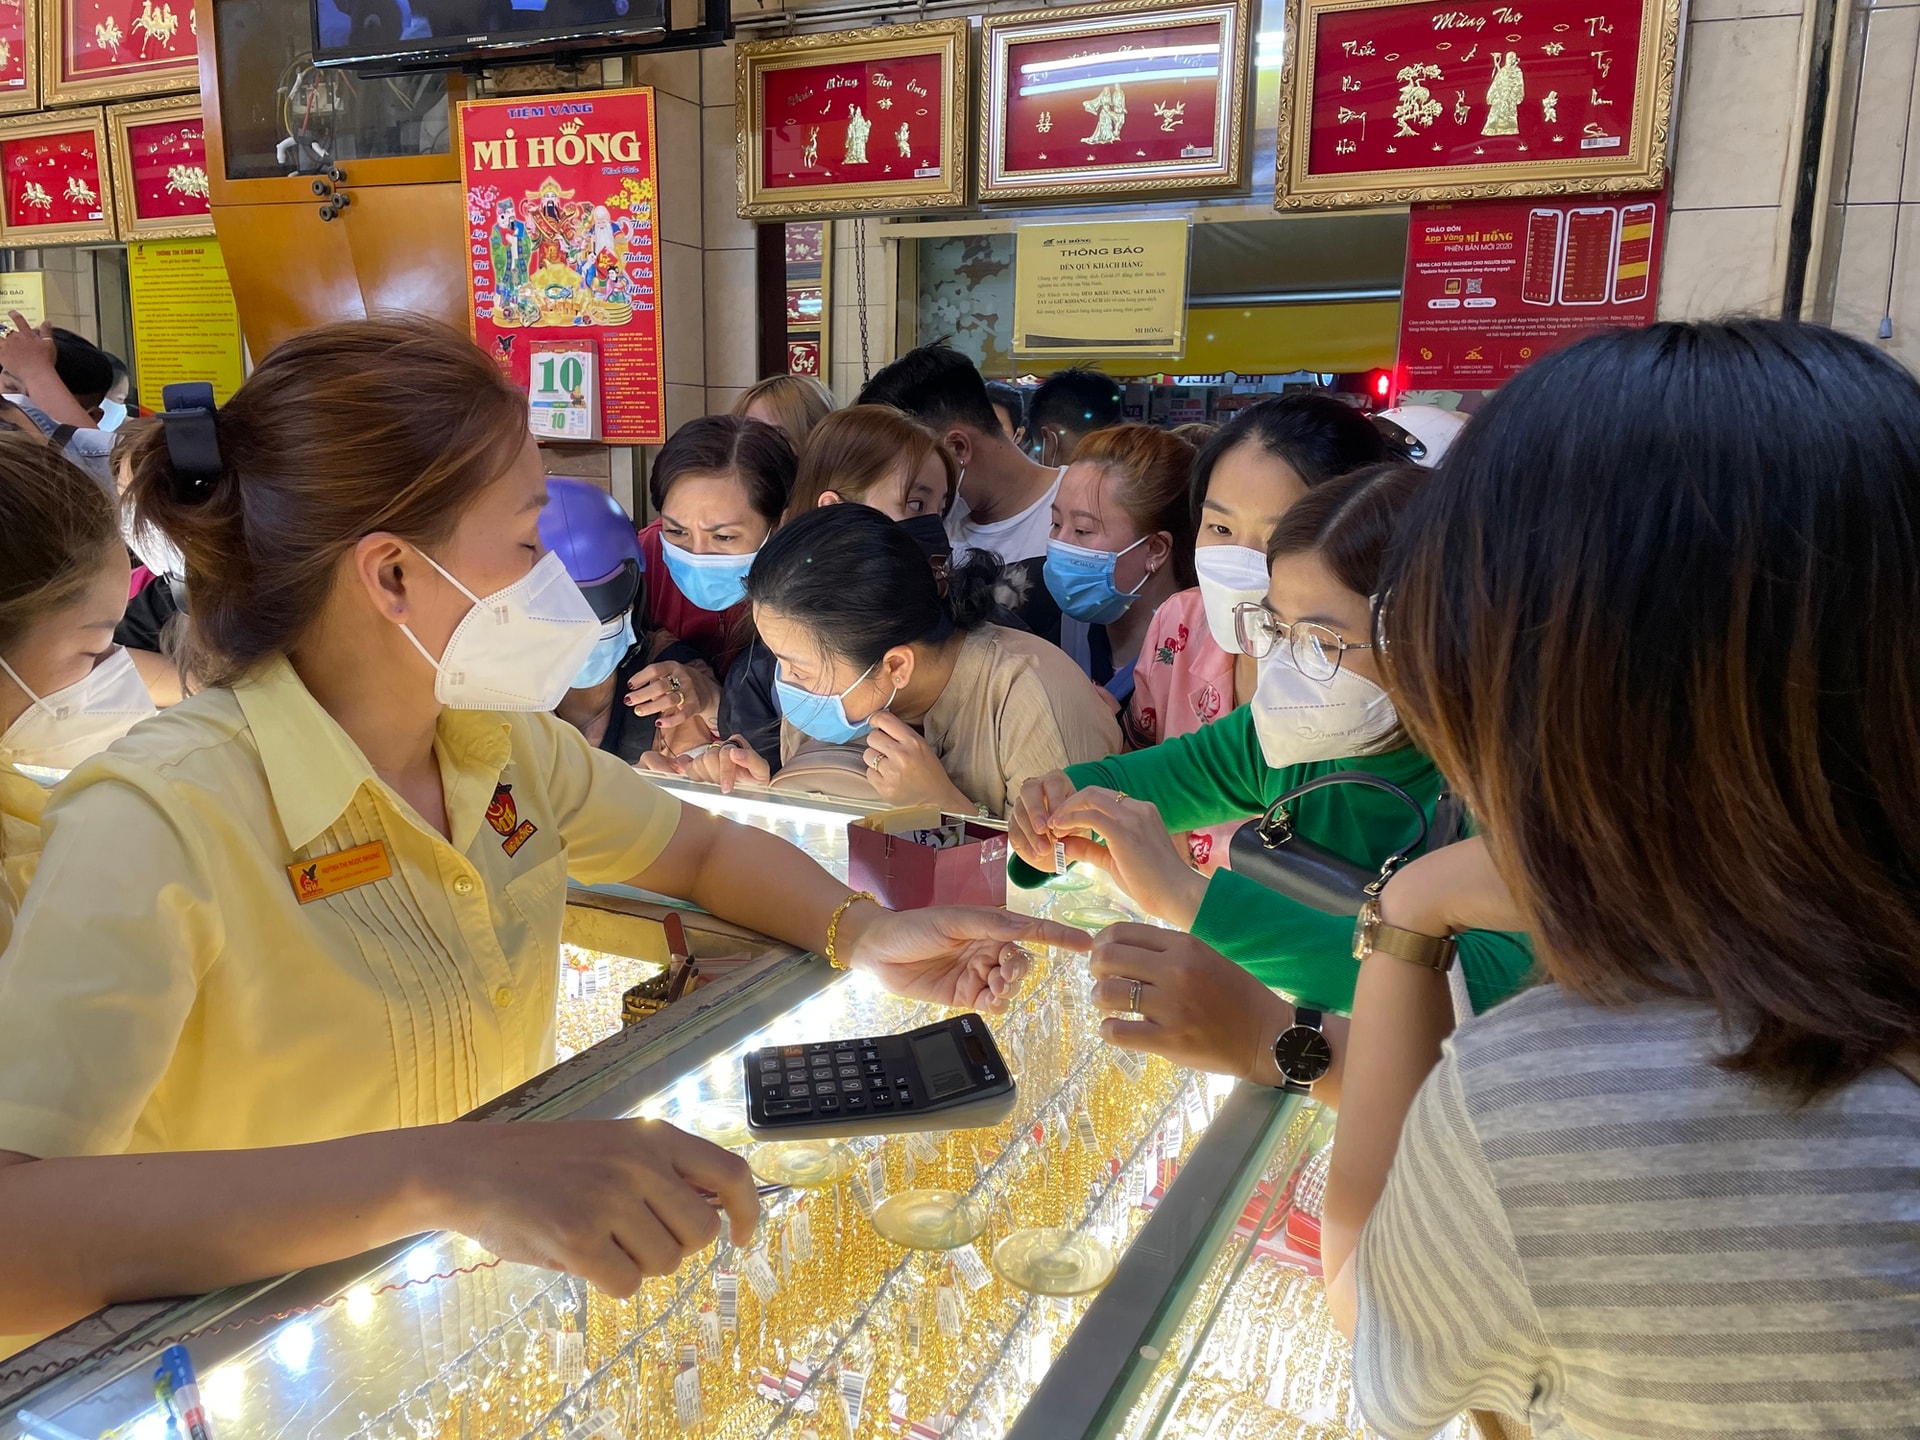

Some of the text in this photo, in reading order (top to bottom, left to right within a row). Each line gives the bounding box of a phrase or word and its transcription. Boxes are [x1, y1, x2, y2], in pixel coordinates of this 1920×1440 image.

[824, 75, 859, 91] Mừng
[872, 73, 893, 90] Thọ
[906, 78, 928, 97] Ông
[507, 103, 593, 120] TIỆM VÀNG
[526, 117, 642, 168] HỒNG
[1425, 235, 1441, 243] App
[1443, 233, 1464, 243] Vàng
[1060, 245, 1144, 257] THÔNG BÁO
[1496, 242, 1512, 250] 2020
[538, 357, 583, 393] 10
[551, 412, 566, 429] 10
[816, 1070, 828, 1079] 5
[842, 1067, 856, 1076] 8
[818, 1084, 832, 1093] 6
[845, 1081, 859, 1091] 9
[792, 1087, 806, 1096] 3
